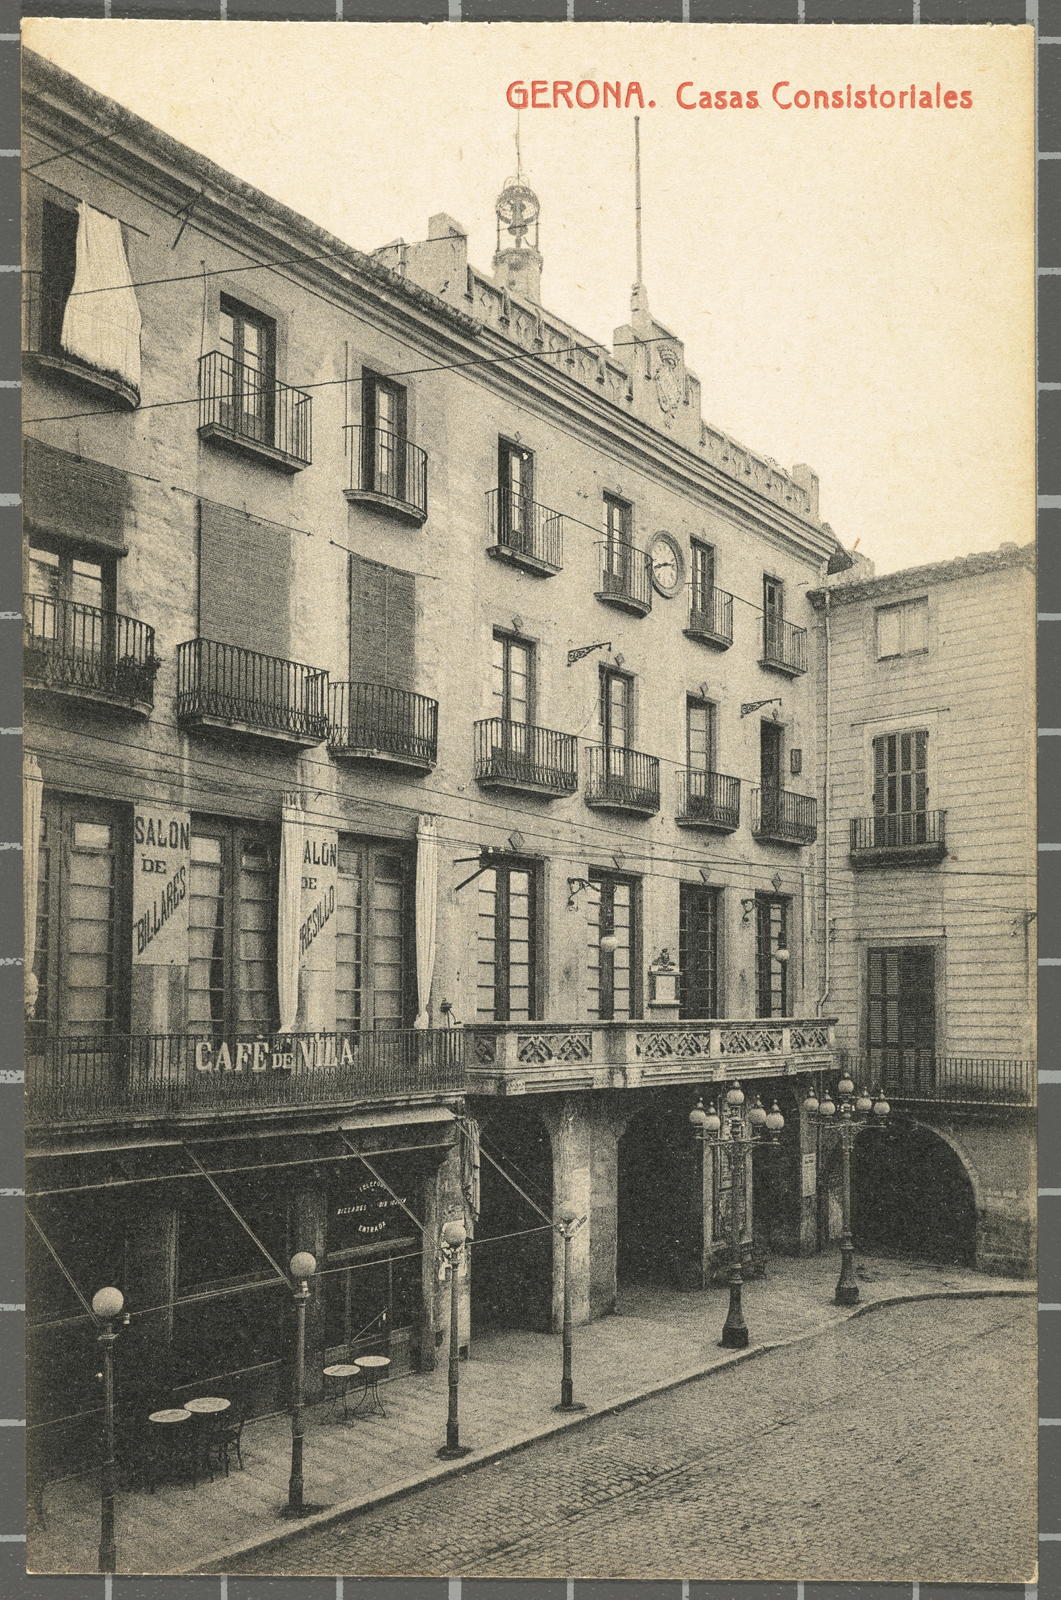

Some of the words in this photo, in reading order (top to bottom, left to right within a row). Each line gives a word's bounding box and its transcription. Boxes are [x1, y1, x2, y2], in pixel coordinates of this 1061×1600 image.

[141, 858, 167, 875] DE
[137, 865, 186, 955] BILLARES
[300, 885, 335, 955] RESILLO
[271, 1052, 294, 1070] DE
[358, 1221, 387, 1234] ENTRADA
